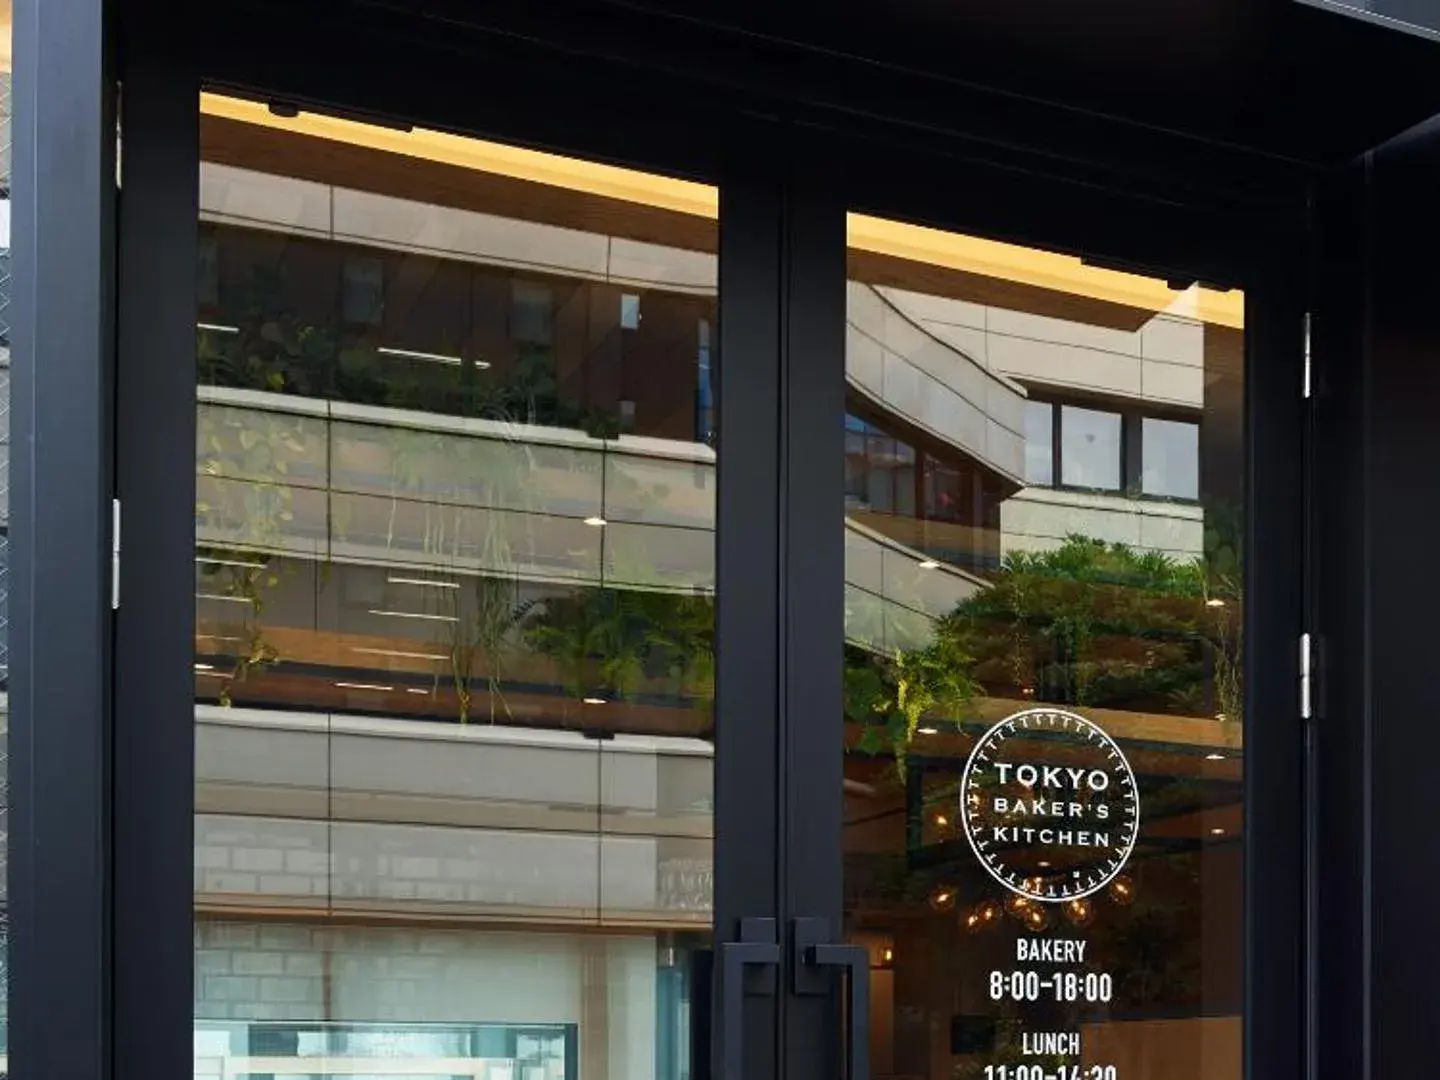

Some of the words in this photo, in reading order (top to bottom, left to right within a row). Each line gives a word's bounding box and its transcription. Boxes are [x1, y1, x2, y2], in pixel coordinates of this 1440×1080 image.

[993, 763, 1109, 791] TOKYO
[993, 798, 1109, 819] BAKER'S
[993, 827, 1109, 847] KITCHEN
[1017, 938, 1086, 962] BAKERY
[1022, 1032, 1080, 1055] LUNCH
